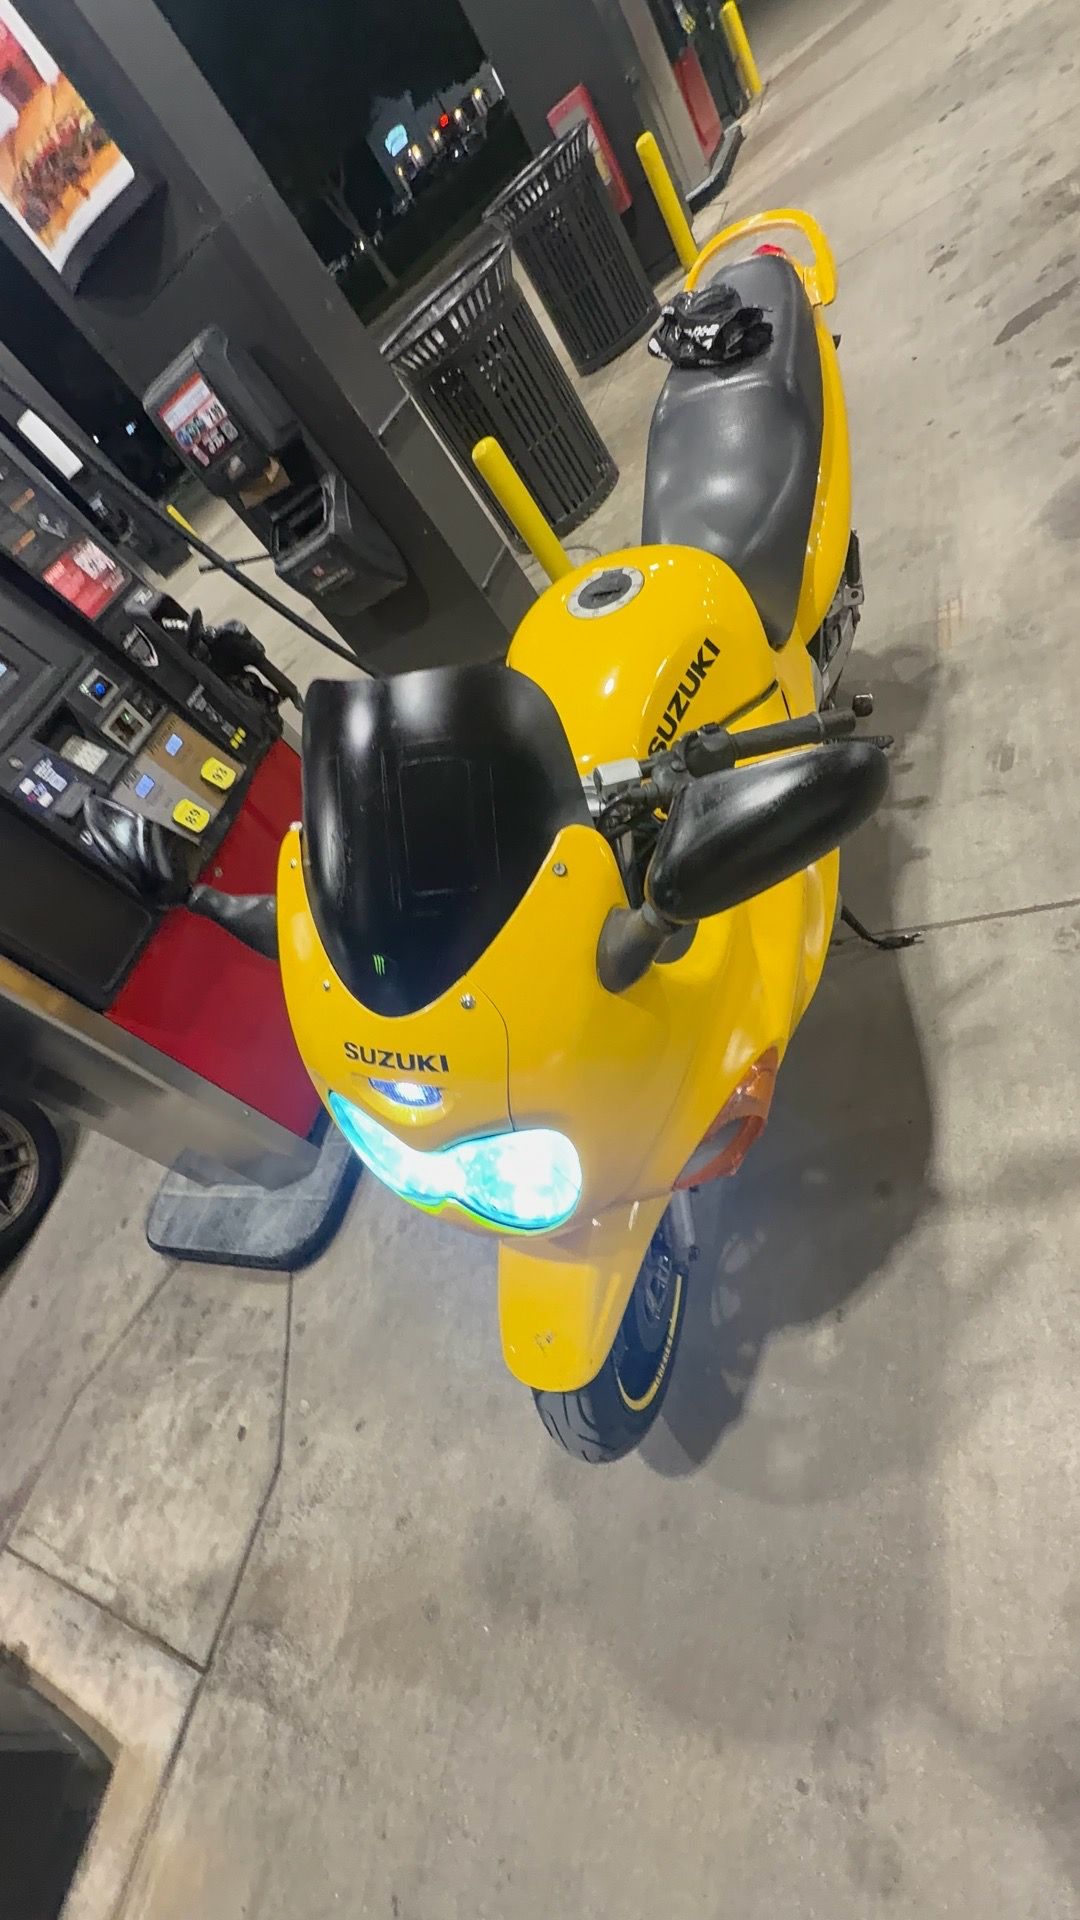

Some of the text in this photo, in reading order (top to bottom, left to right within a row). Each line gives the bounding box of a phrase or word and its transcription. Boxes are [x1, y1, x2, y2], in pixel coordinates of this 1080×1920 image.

[648, 637, 721, 757] SUZUKI
[184, 808, 201, 825] 89
[343, 1041, 450, 1073] SUZUKI
